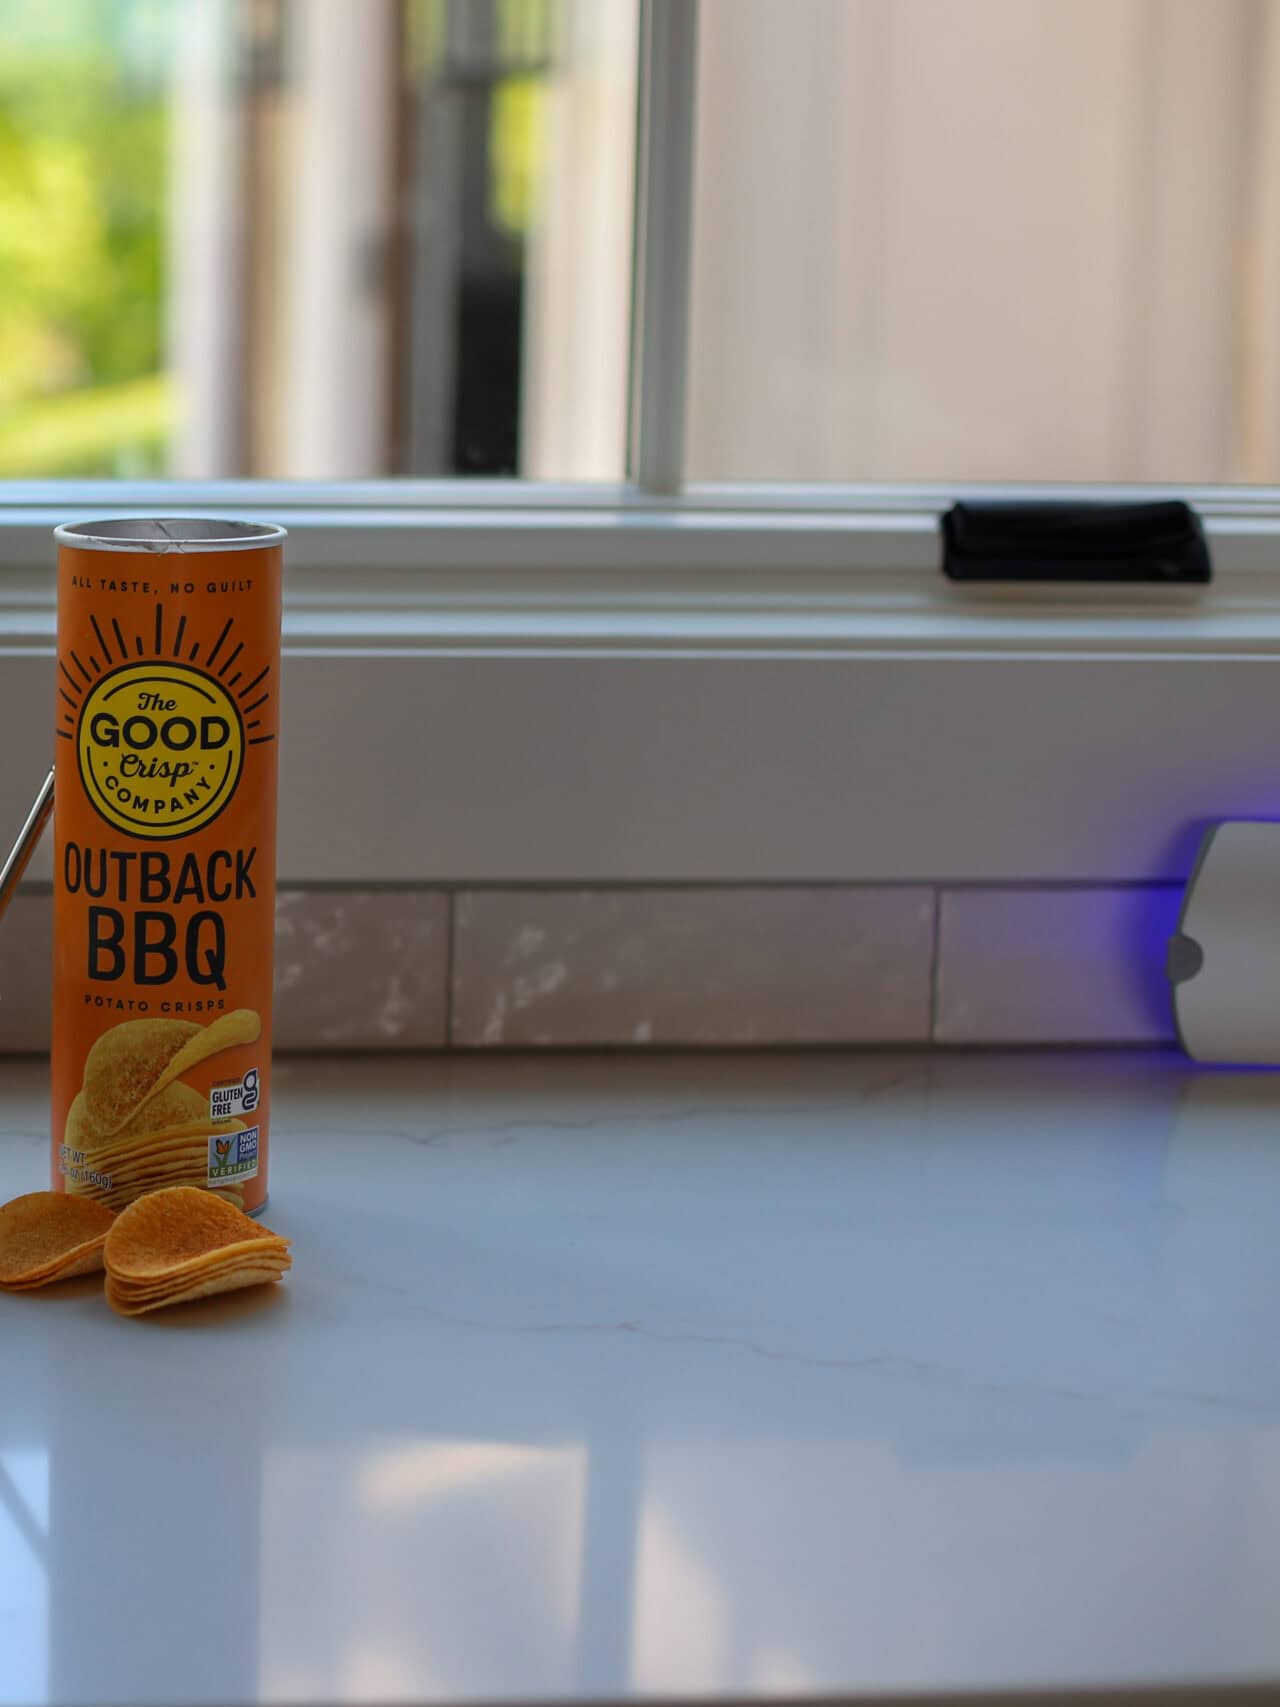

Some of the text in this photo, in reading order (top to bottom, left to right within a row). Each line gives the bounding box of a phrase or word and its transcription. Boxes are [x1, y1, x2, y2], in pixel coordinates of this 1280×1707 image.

[71, 575, 254, 594] ALL TASTE, NO GUILT
[137, 692, 178, 712] The
[89, 712, 231, 751] GOOD
[103, 774, 213, 814] COMPANY
[64, 841, 258, 905] OUTBACK
[86, 905, 227, 991] BBQ
[83, 994, 226, 1013] POTATO CRISPS
[212, 1087, 243, 1103] GLUTEN
[211, 1102, 232, 1116] FREE
[239, 1130, 257, 1143] NON
[239, 1142, 257, 1153] GMO
[212, 1160, 257, 1177] VERIFIED
